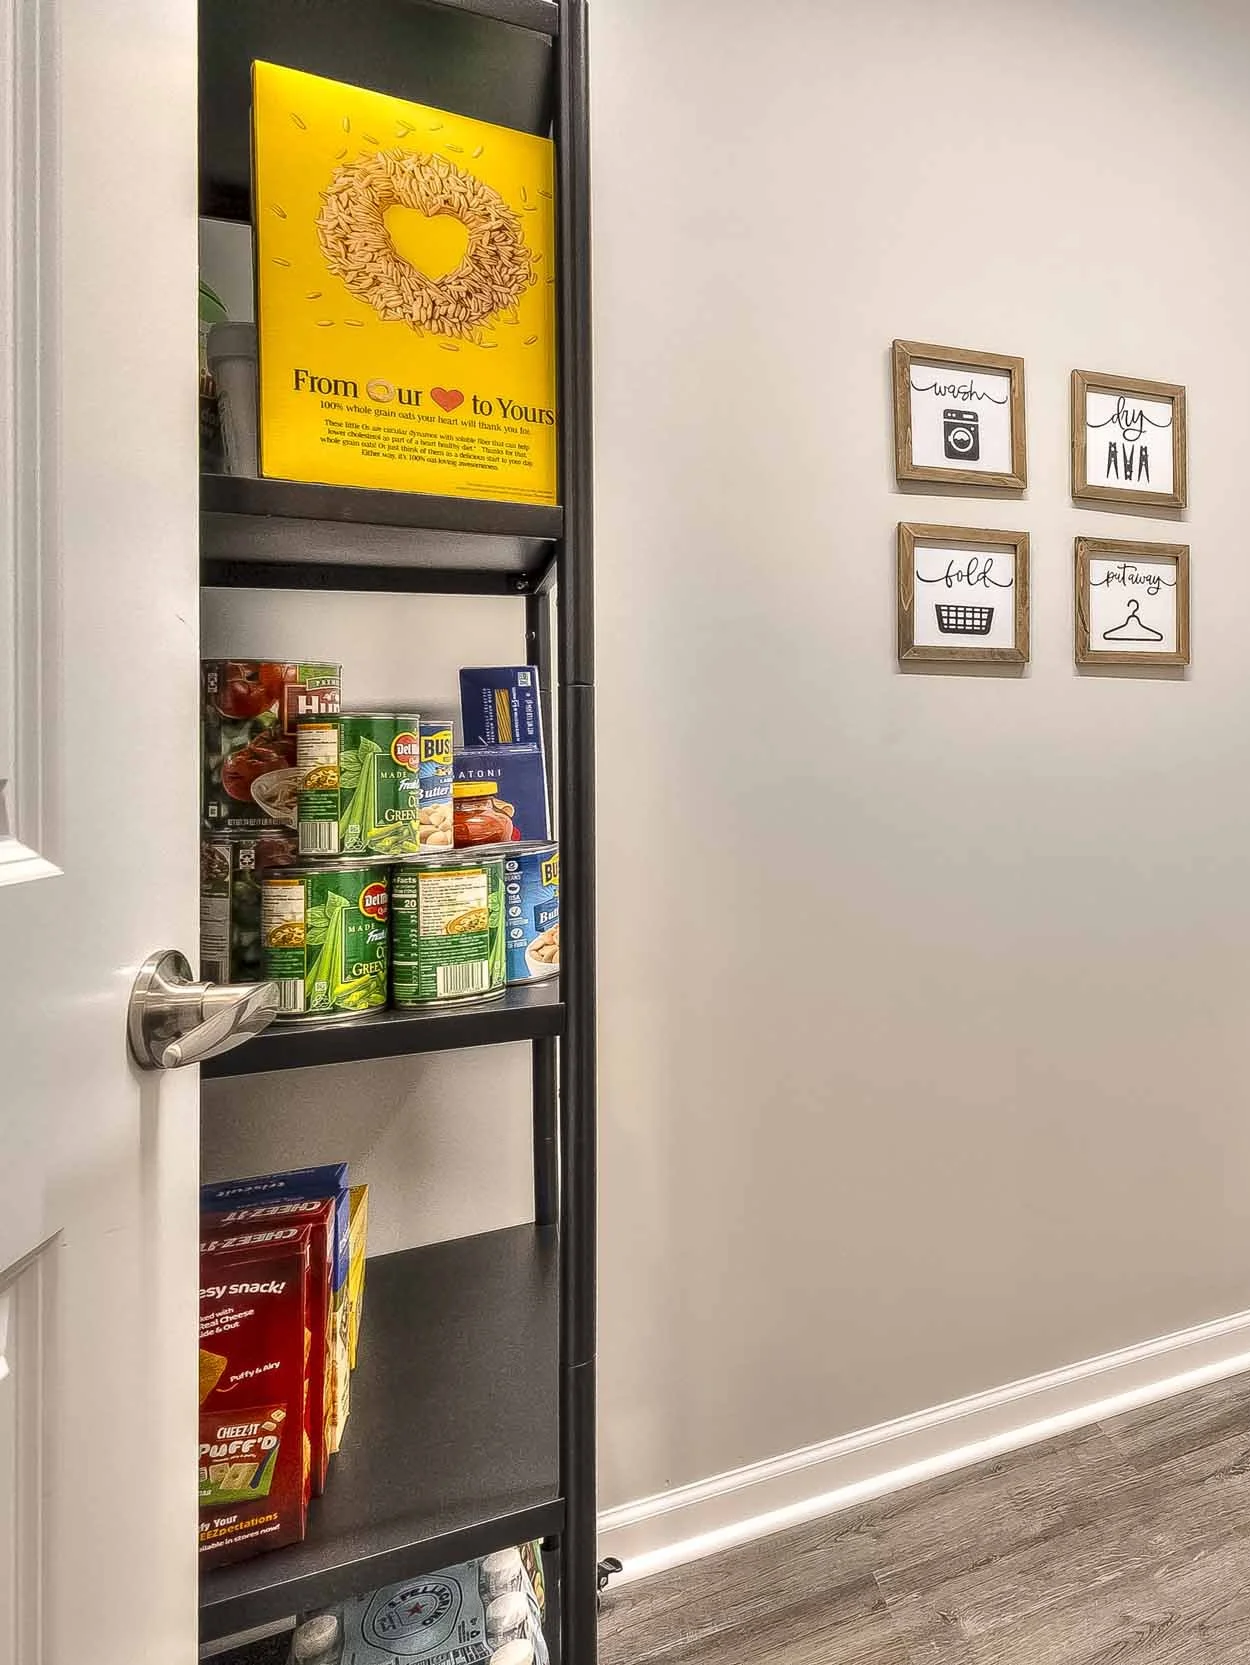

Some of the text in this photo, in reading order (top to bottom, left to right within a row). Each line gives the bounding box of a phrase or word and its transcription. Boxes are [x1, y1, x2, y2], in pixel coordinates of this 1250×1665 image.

[293, 369, 360, 398] From
[472, 395, 493, 416] to
[496, 397, 555, 426] Yours
[911, 379, 1009, 405] wash
[320, 400, 343, 411] 100%
[345, 404, 373, 415] whole
[374, 408, 397, 418] grain
[398, 411, 416, 420] oats
[416, 414, 436, 424] your
[438, 416, 459, 426] heart
[460, 420, 477, 429] will
[478, 421, 502, 432] thank
[503, 425, 519, 435] you
[1086, 395, 1173, 442] dry
[916, 556, 1014, 588] fold
[424, 739, 450, 759] BUS
[381, 771, 408, 779] MADE
[452, 769, 501, 780] ATONI
[404, 899, 417, 908] 20
[348, 923, 376, 933] MADE
[228, 1280, 287, 1295] snack!
[219, 1309, 255, 1324] Cheese
[230, 1361, 281, 1383] Puffy & Airy
[216, 1423, 261, 1440] CHEEZ-IT
[213, 1514, 238, 1528] Your
[234, 1531, 260, 1543] stores
